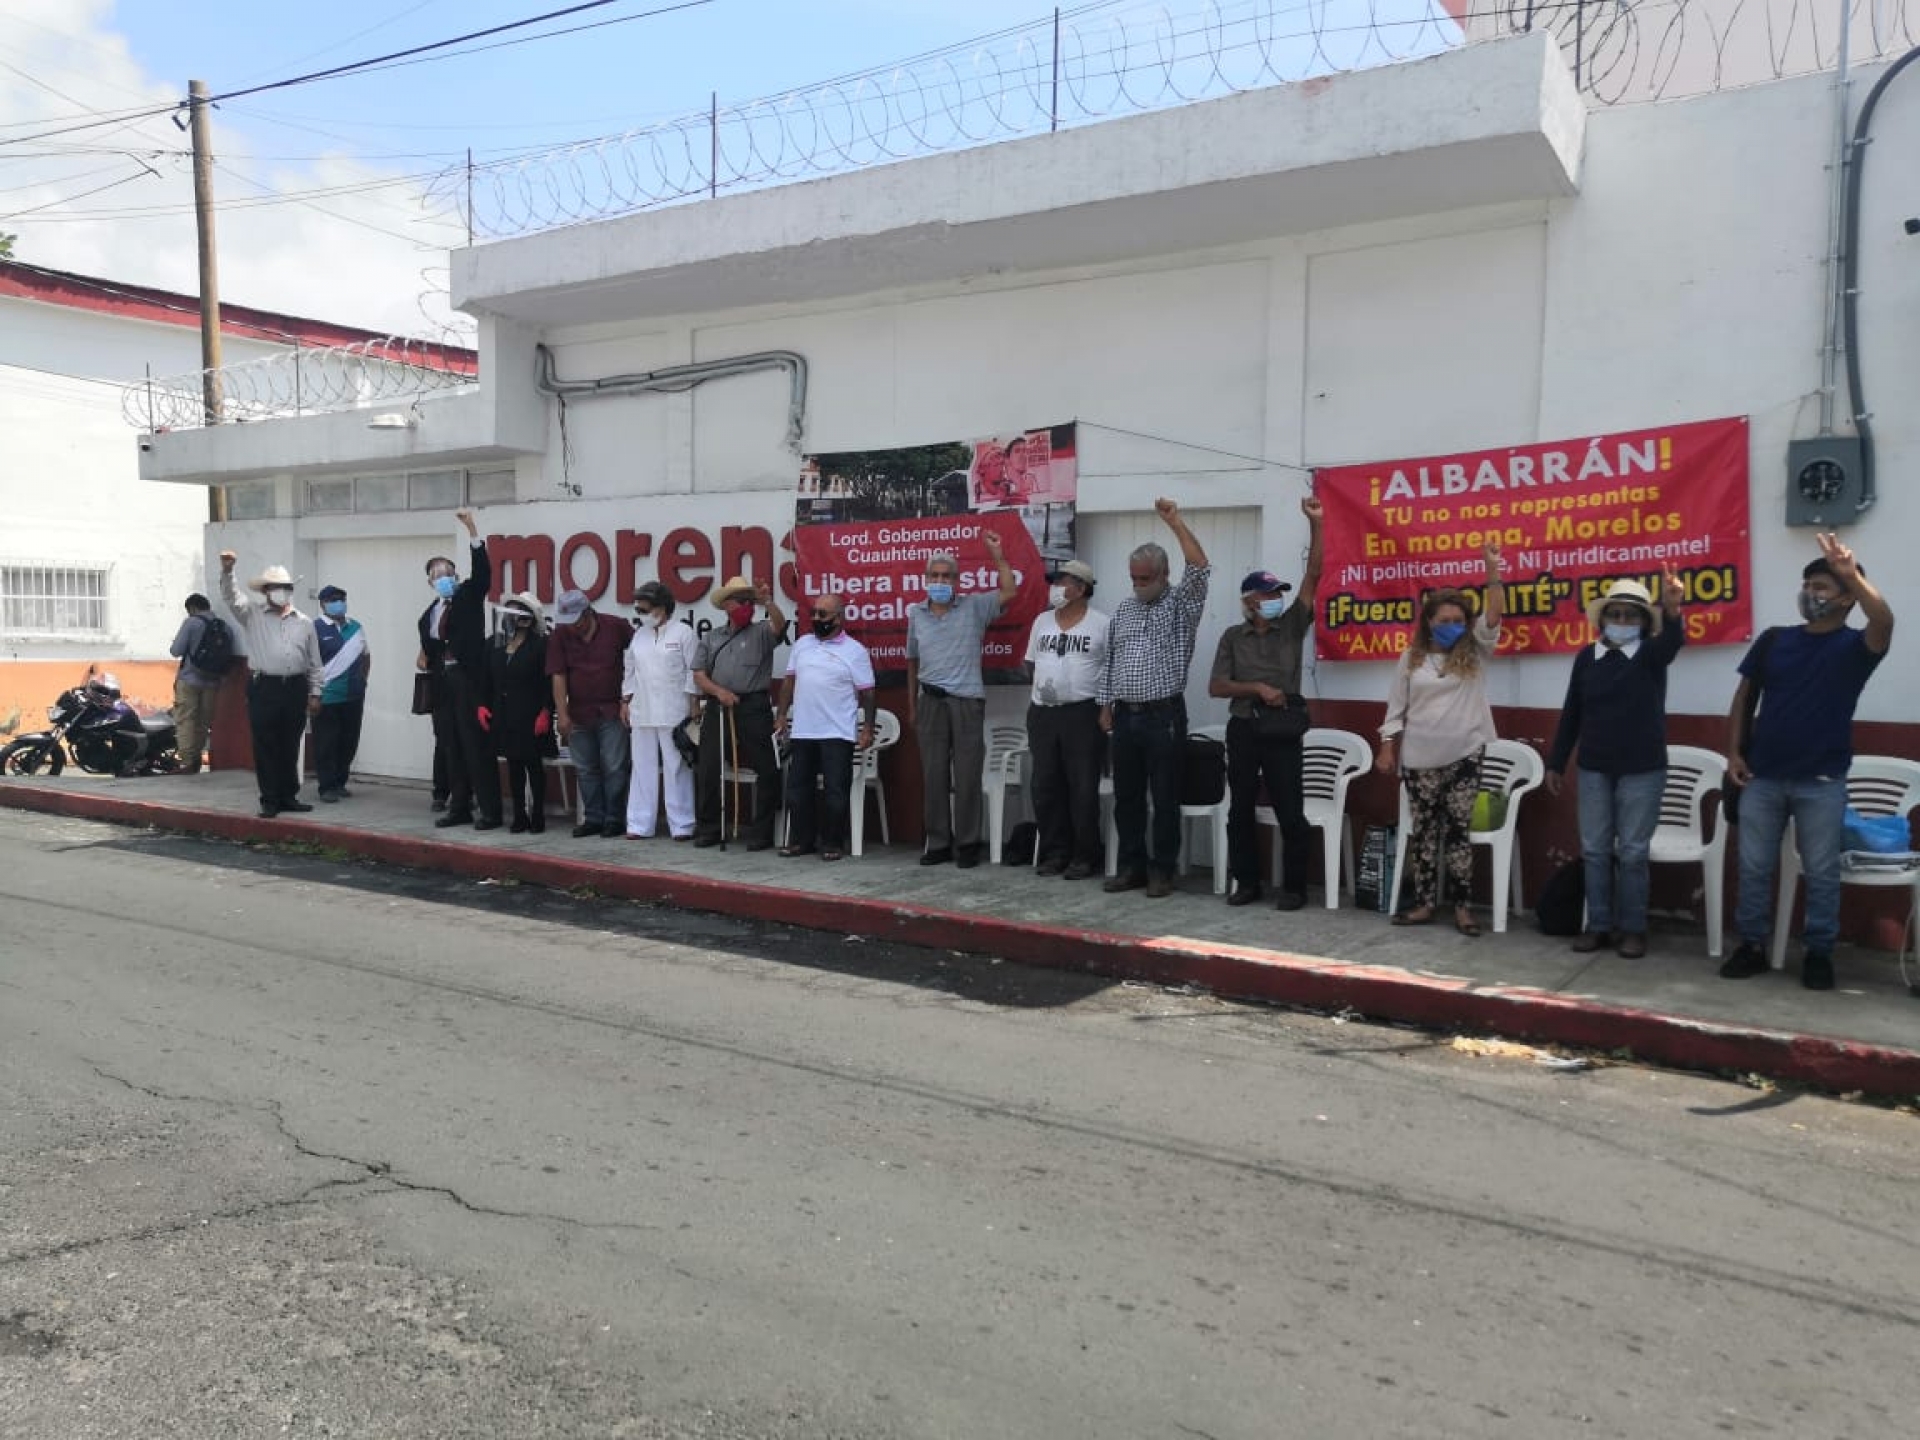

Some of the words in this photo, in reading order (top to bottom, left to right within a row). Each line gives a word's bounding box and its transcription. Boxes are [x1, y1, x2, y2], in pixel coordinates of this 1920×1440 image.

[1370, 437, 1672, 506] ¡ALBARRÁN!
[1383, 506, 1413, 526] TU
[1422, 508, 1450, 523] no
[1460, 503, 1501, 519] nos
[1510, 485, 1661, 518] representas
[878, 524, 981, 545] Gobernador
[1366, 532, 1396, 556] En
[1408, 527, 1533, 553] morena,
[1545, 508, 1681, 542] Morelos
[1519, 551, 1541, 570] Ni
[804, 572, 893, 596] Libera
[903, 566, 1023, 592] nstr
[1328, 595, 1414, 628] ¡Fuera
